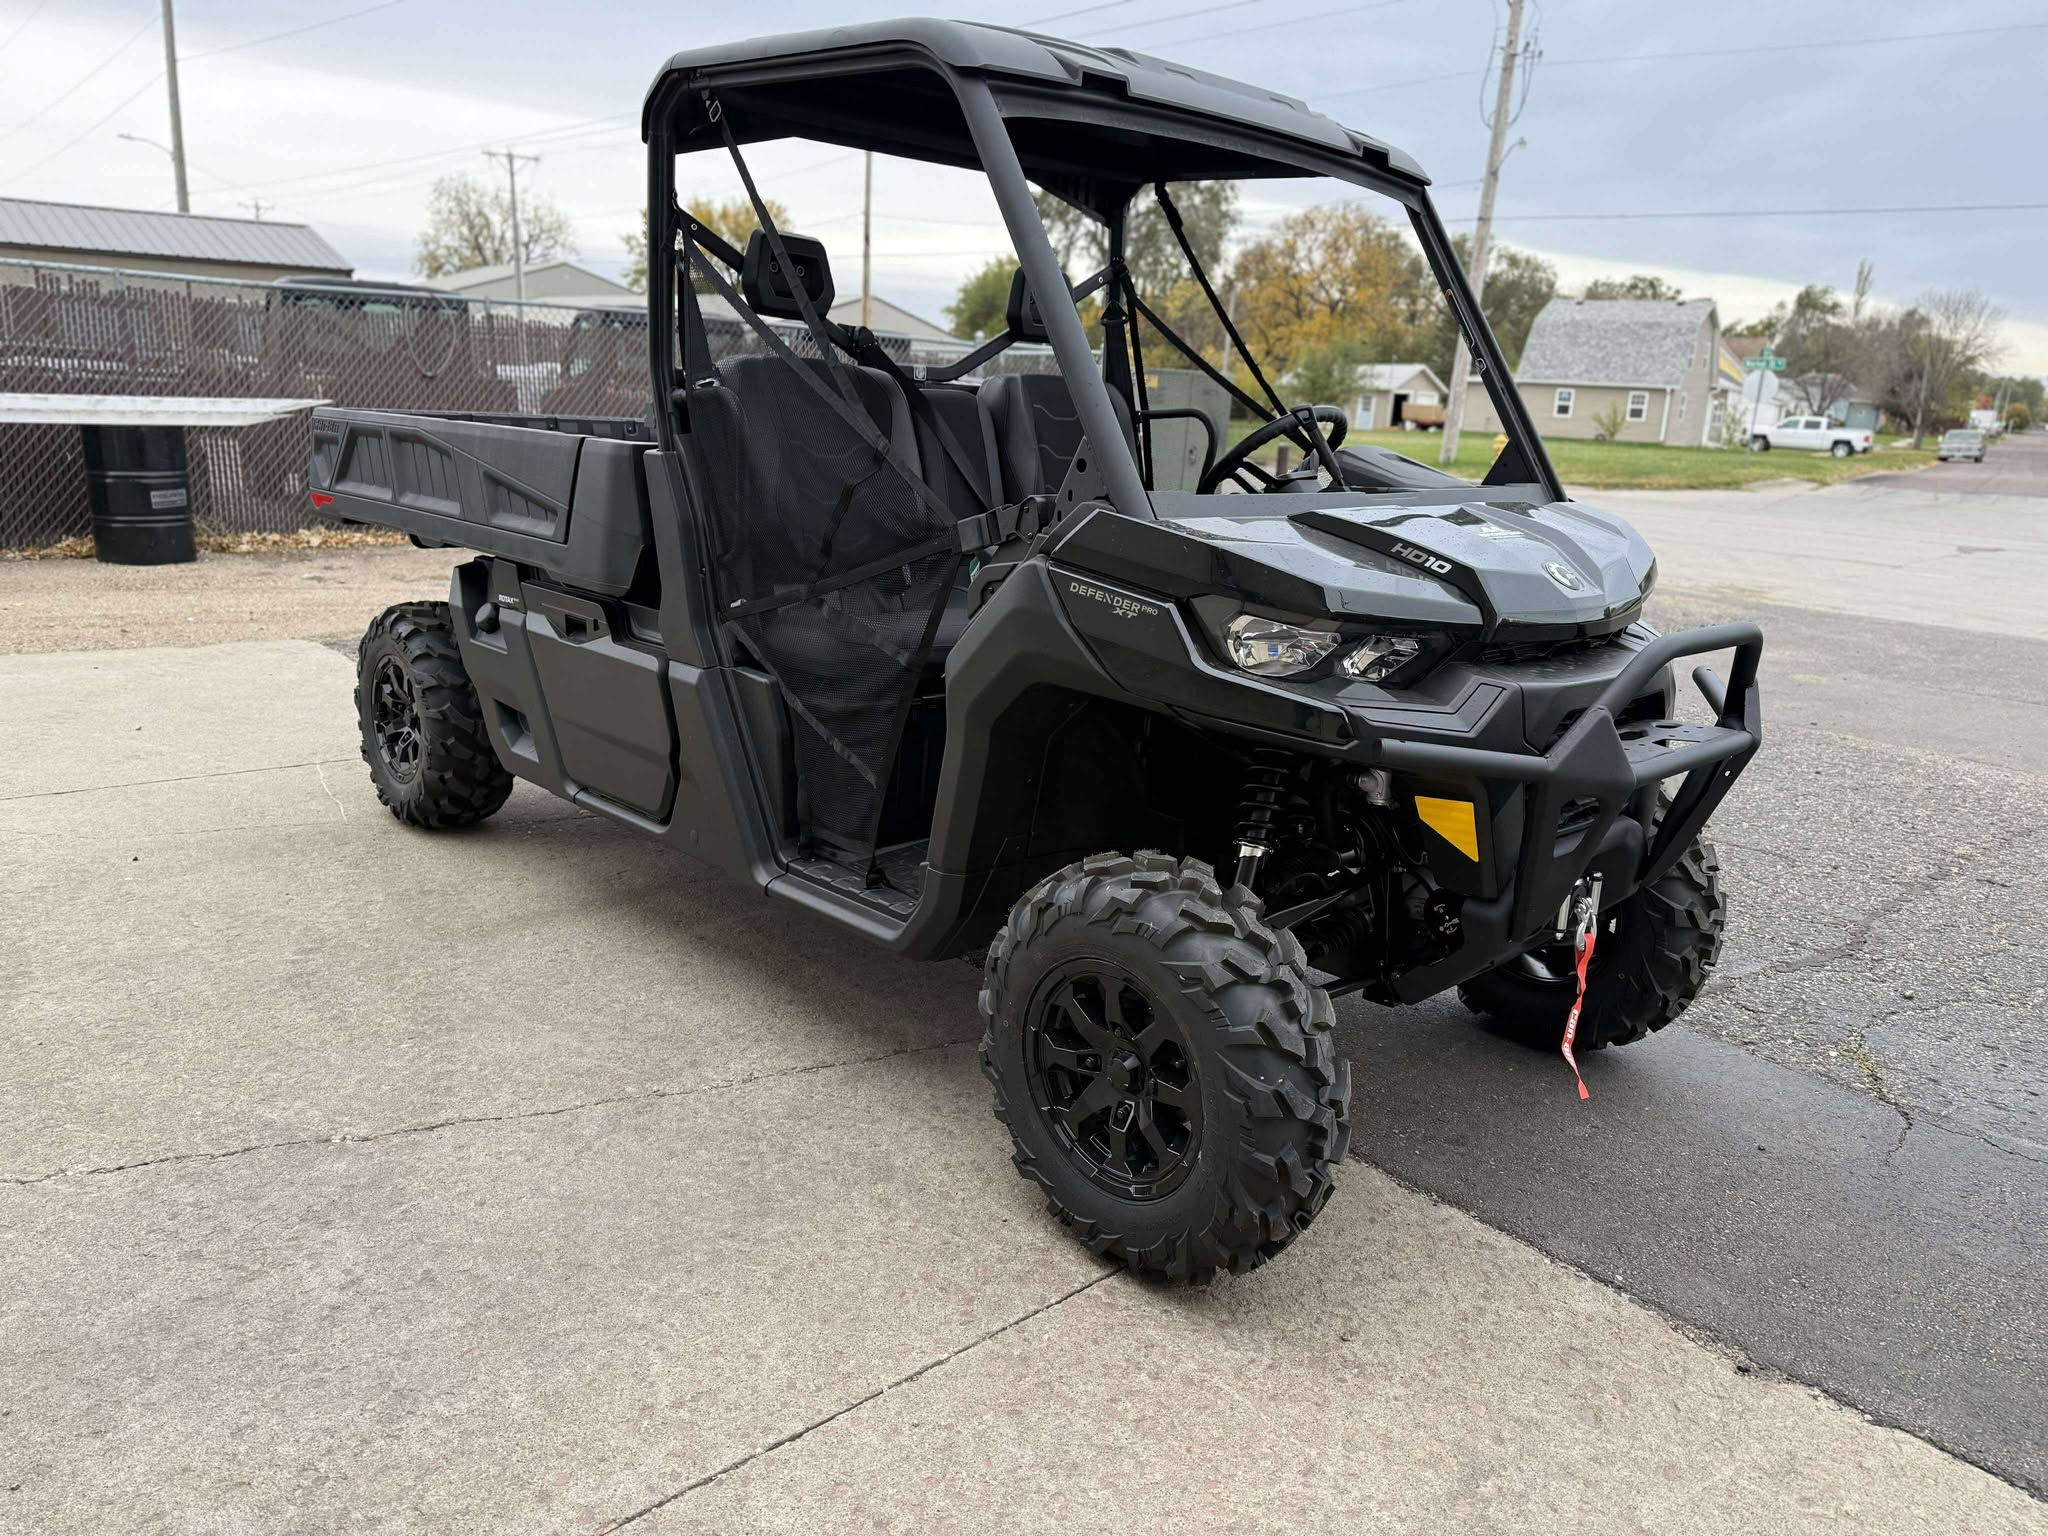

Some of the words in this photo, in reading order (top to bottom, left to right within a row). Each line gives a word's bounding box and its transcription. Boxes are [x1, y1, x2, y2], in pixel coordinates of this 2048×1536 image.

[1390, 542, 1452, 574] HD10
[1070, 582, 1140, 613] DEFENDER
[1141, 605, 1158, 616] PRO
[1112, 607, 1138, 619] XT
